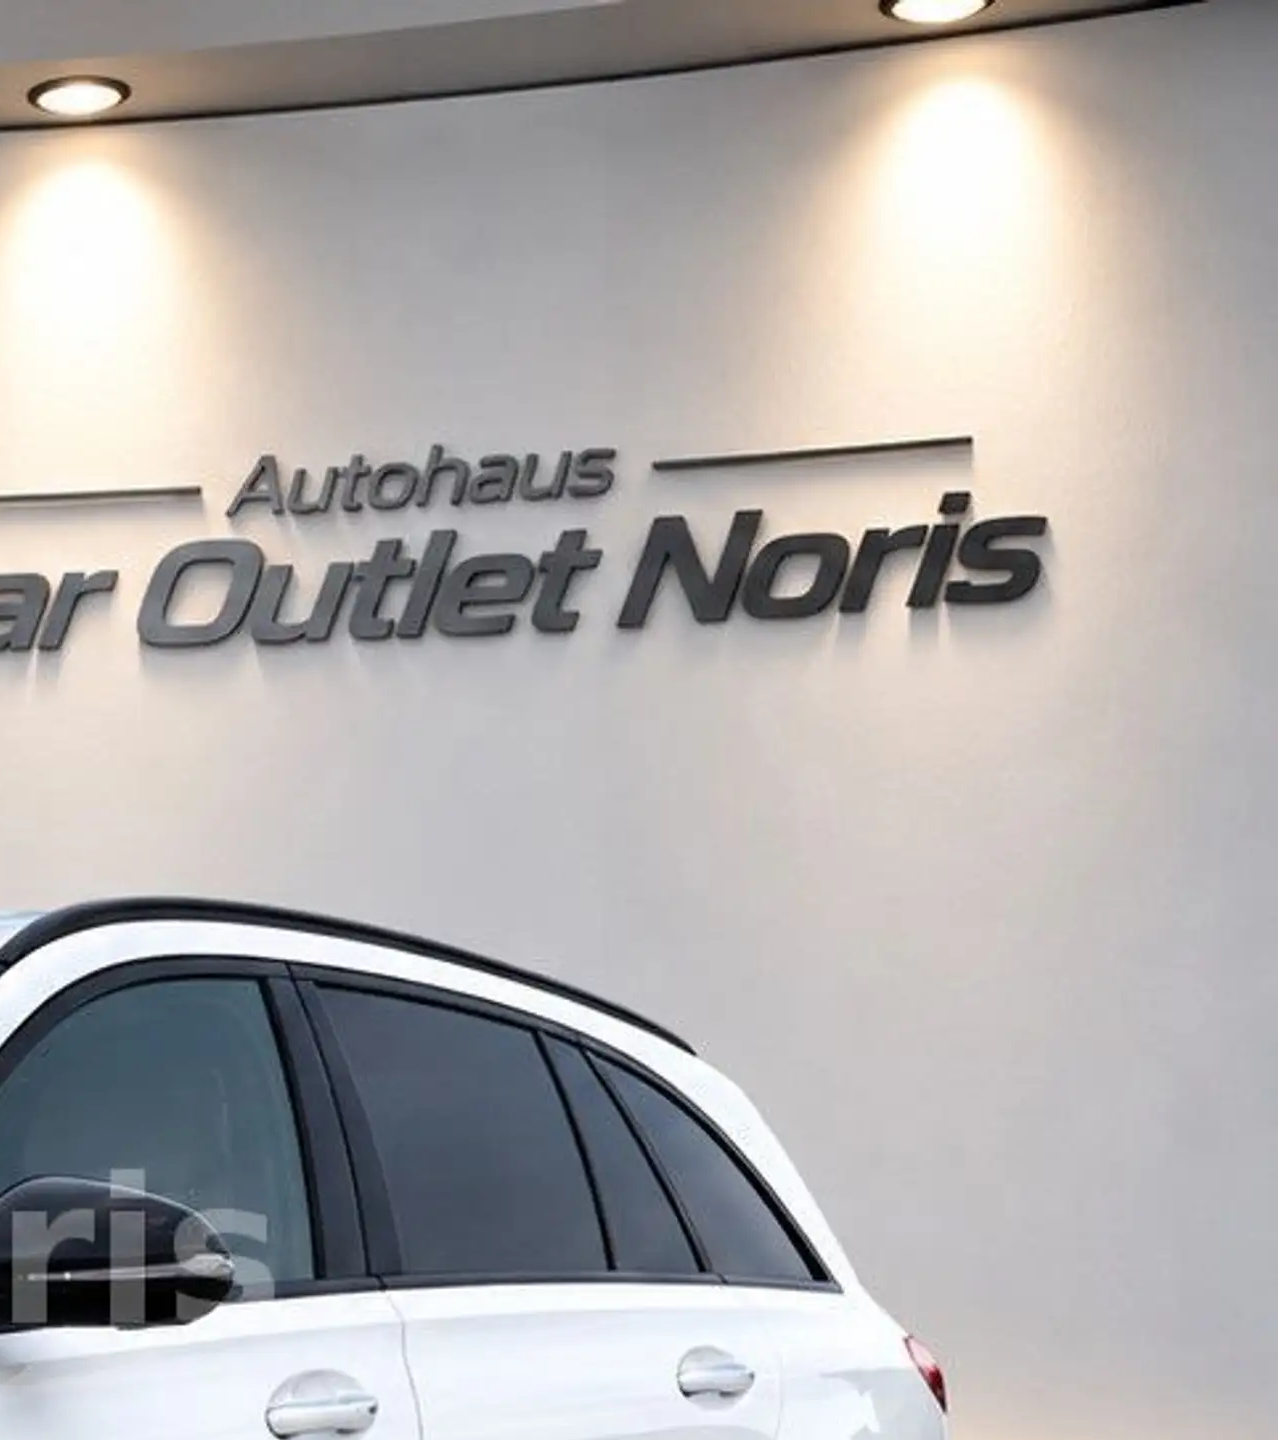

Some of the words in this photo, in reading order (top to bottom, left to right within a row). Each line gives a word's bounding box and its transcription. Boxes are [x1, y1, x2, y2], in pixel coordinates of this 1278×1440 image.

[226, 444, 616, 517] Autohaus
[136, 529, 604, 648] Outlet
[616, 491, 1048, 628] Noris
